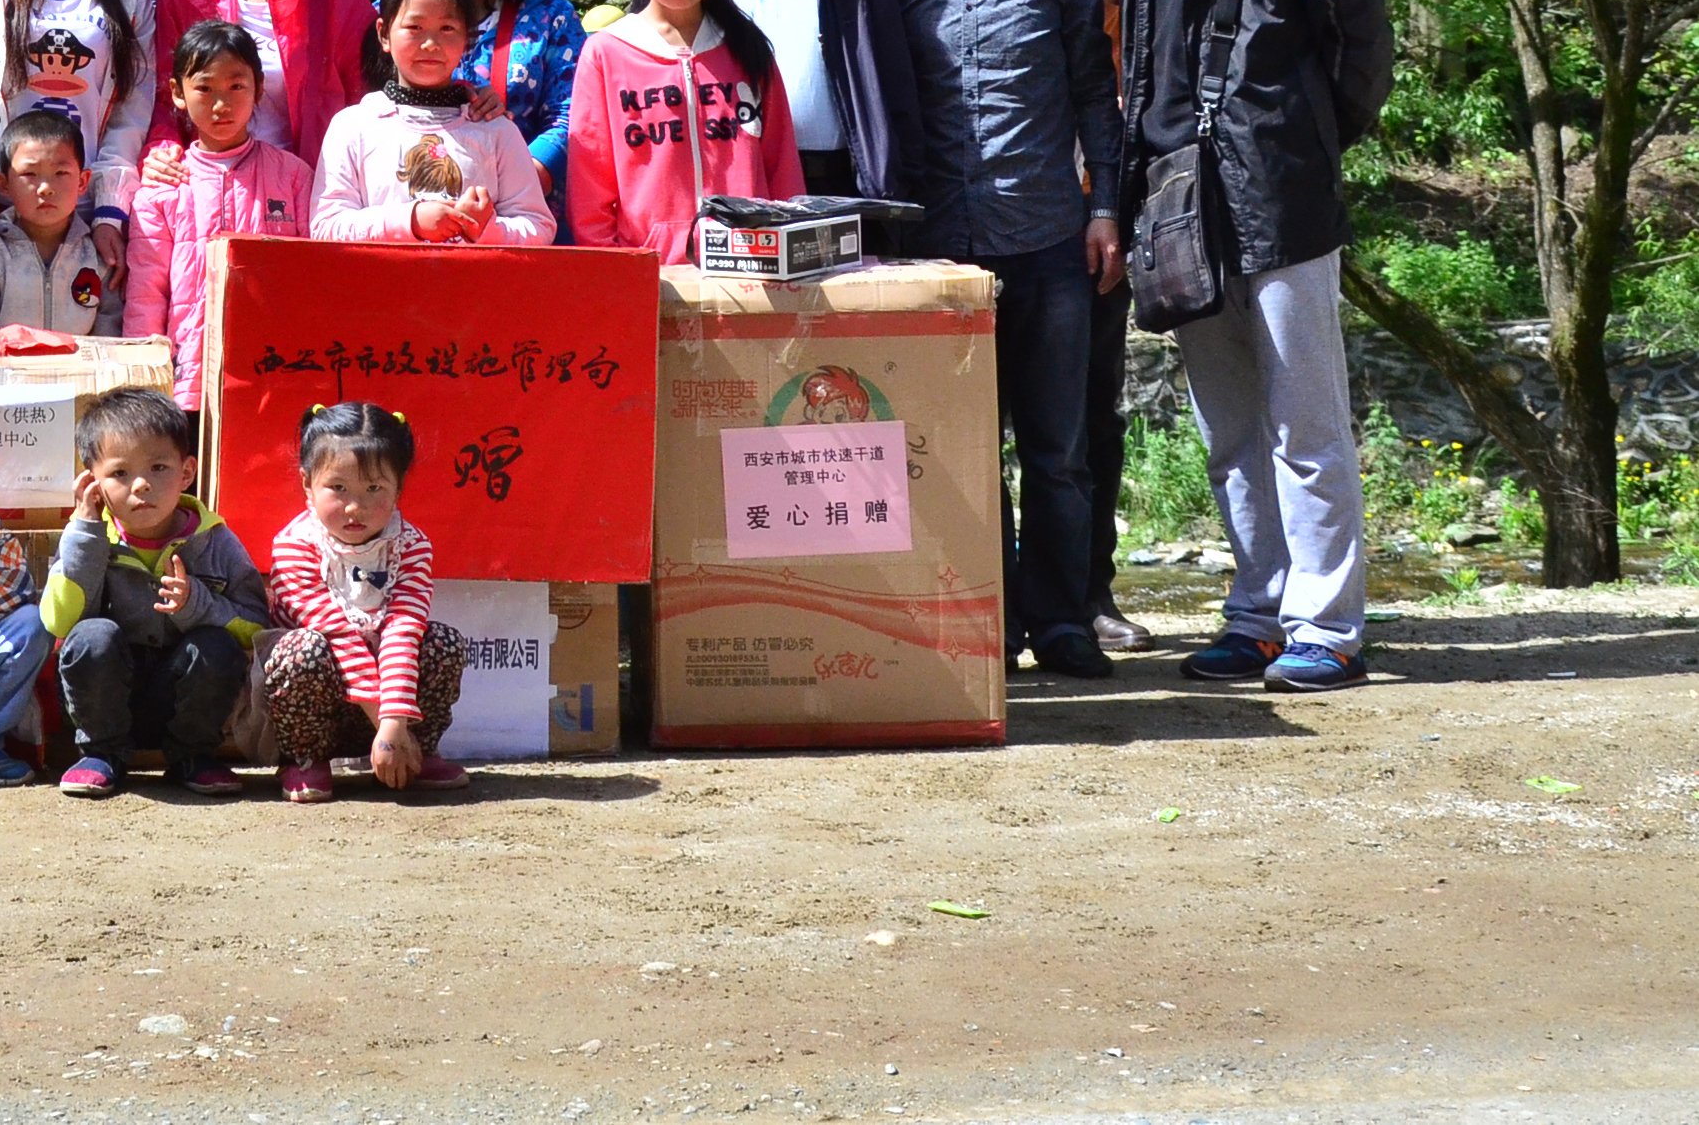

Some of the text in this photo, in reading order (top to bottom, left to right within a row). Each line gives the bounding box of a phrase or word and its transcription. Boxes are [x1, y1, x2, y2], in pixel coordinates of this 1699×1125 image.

[744, 446, 885, 467] 西安市城市快速干道
[784, 469, 847, 486] 管理中心
[686, 637, 814, 651] 专利产品 仿冒必究
